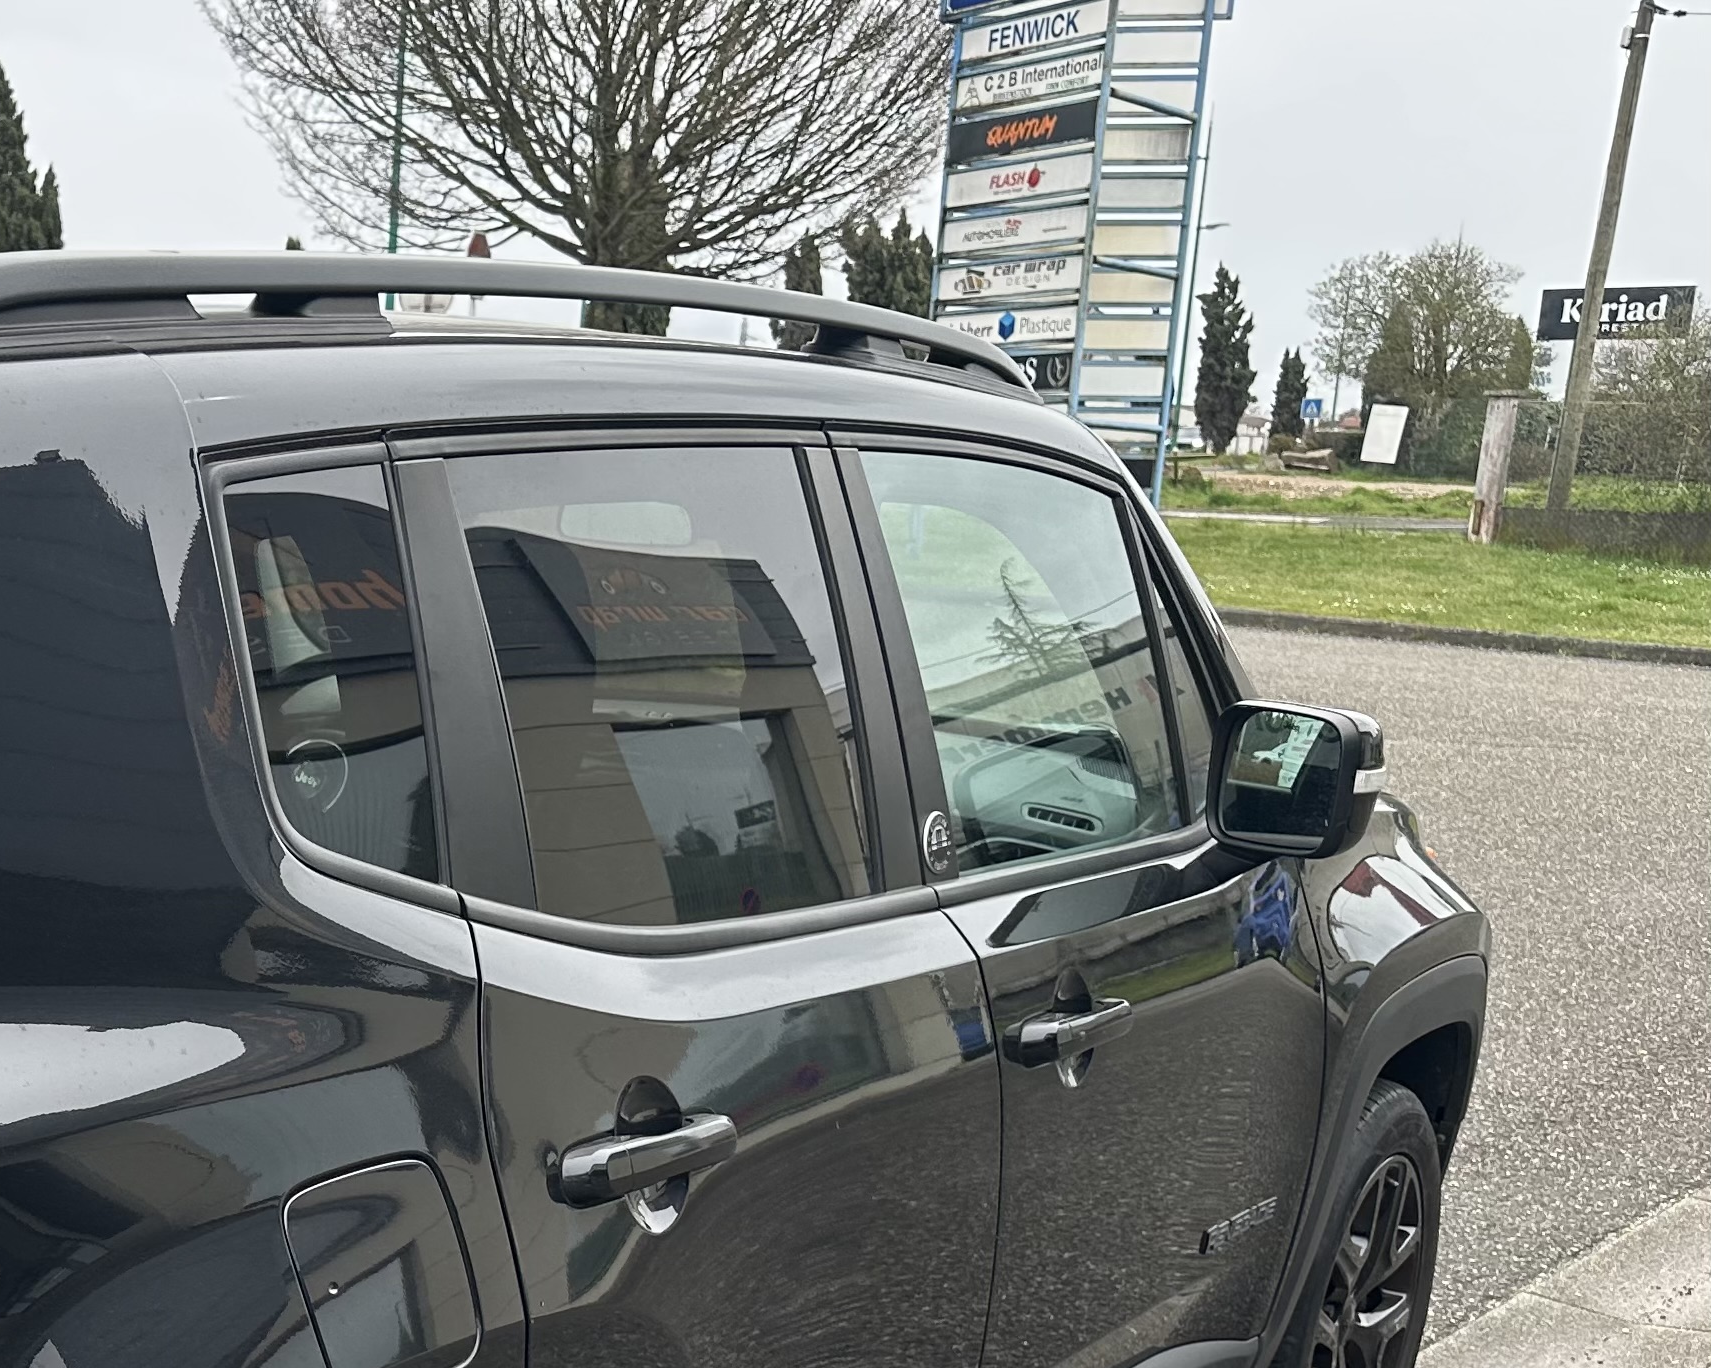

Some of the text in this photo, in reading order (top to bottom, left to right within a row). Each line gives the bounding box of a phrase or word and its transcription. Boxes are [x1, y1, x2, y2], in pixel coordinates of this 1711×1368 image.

[988, 10, 1080, 52] FENWICK
[984, 52, 1103, 92] C 2 B International
[986, 113, 1058, 147] QUANTUM
[989, 171, 1026, 189] FLASH
[992, 259, 1066, 277] car wrap
[1005, 274, 1051, 287] DESIGN
[1560, 294, 1669, 323] Kriad
[1019, 315, 1071, 339] Plastique
